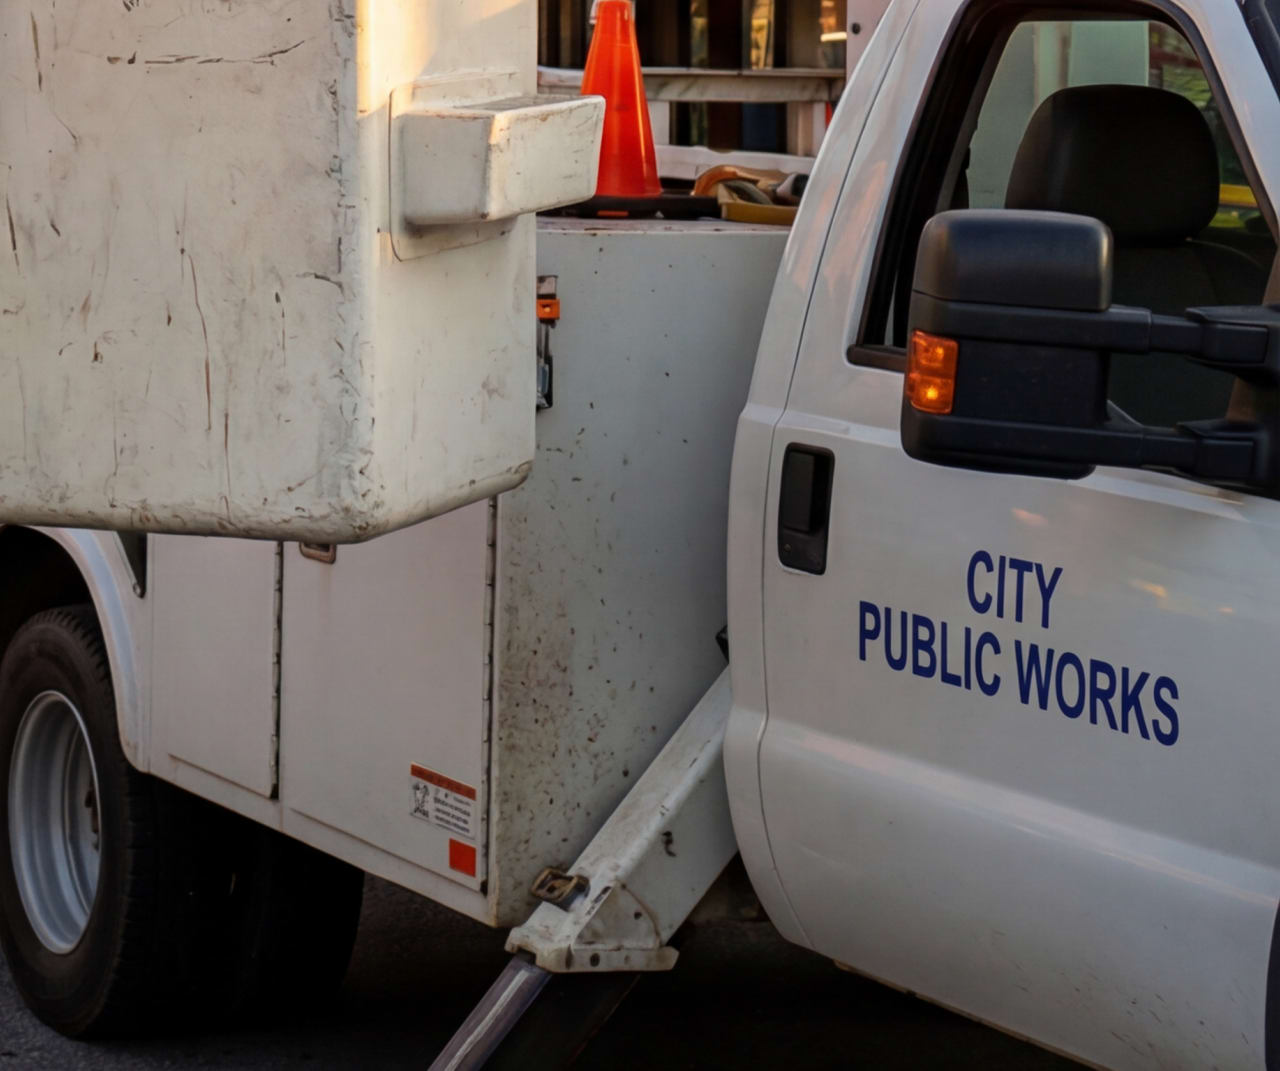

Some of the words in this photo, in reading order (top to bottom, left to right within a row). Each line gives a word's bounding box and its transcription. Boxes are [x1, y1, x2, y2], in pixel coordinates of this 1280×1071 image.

[966, 550, 1064, 629] CITY
[858, 601, 1002, 697] PUBLIC
[1015, 639, 1181, 747] WORKS
